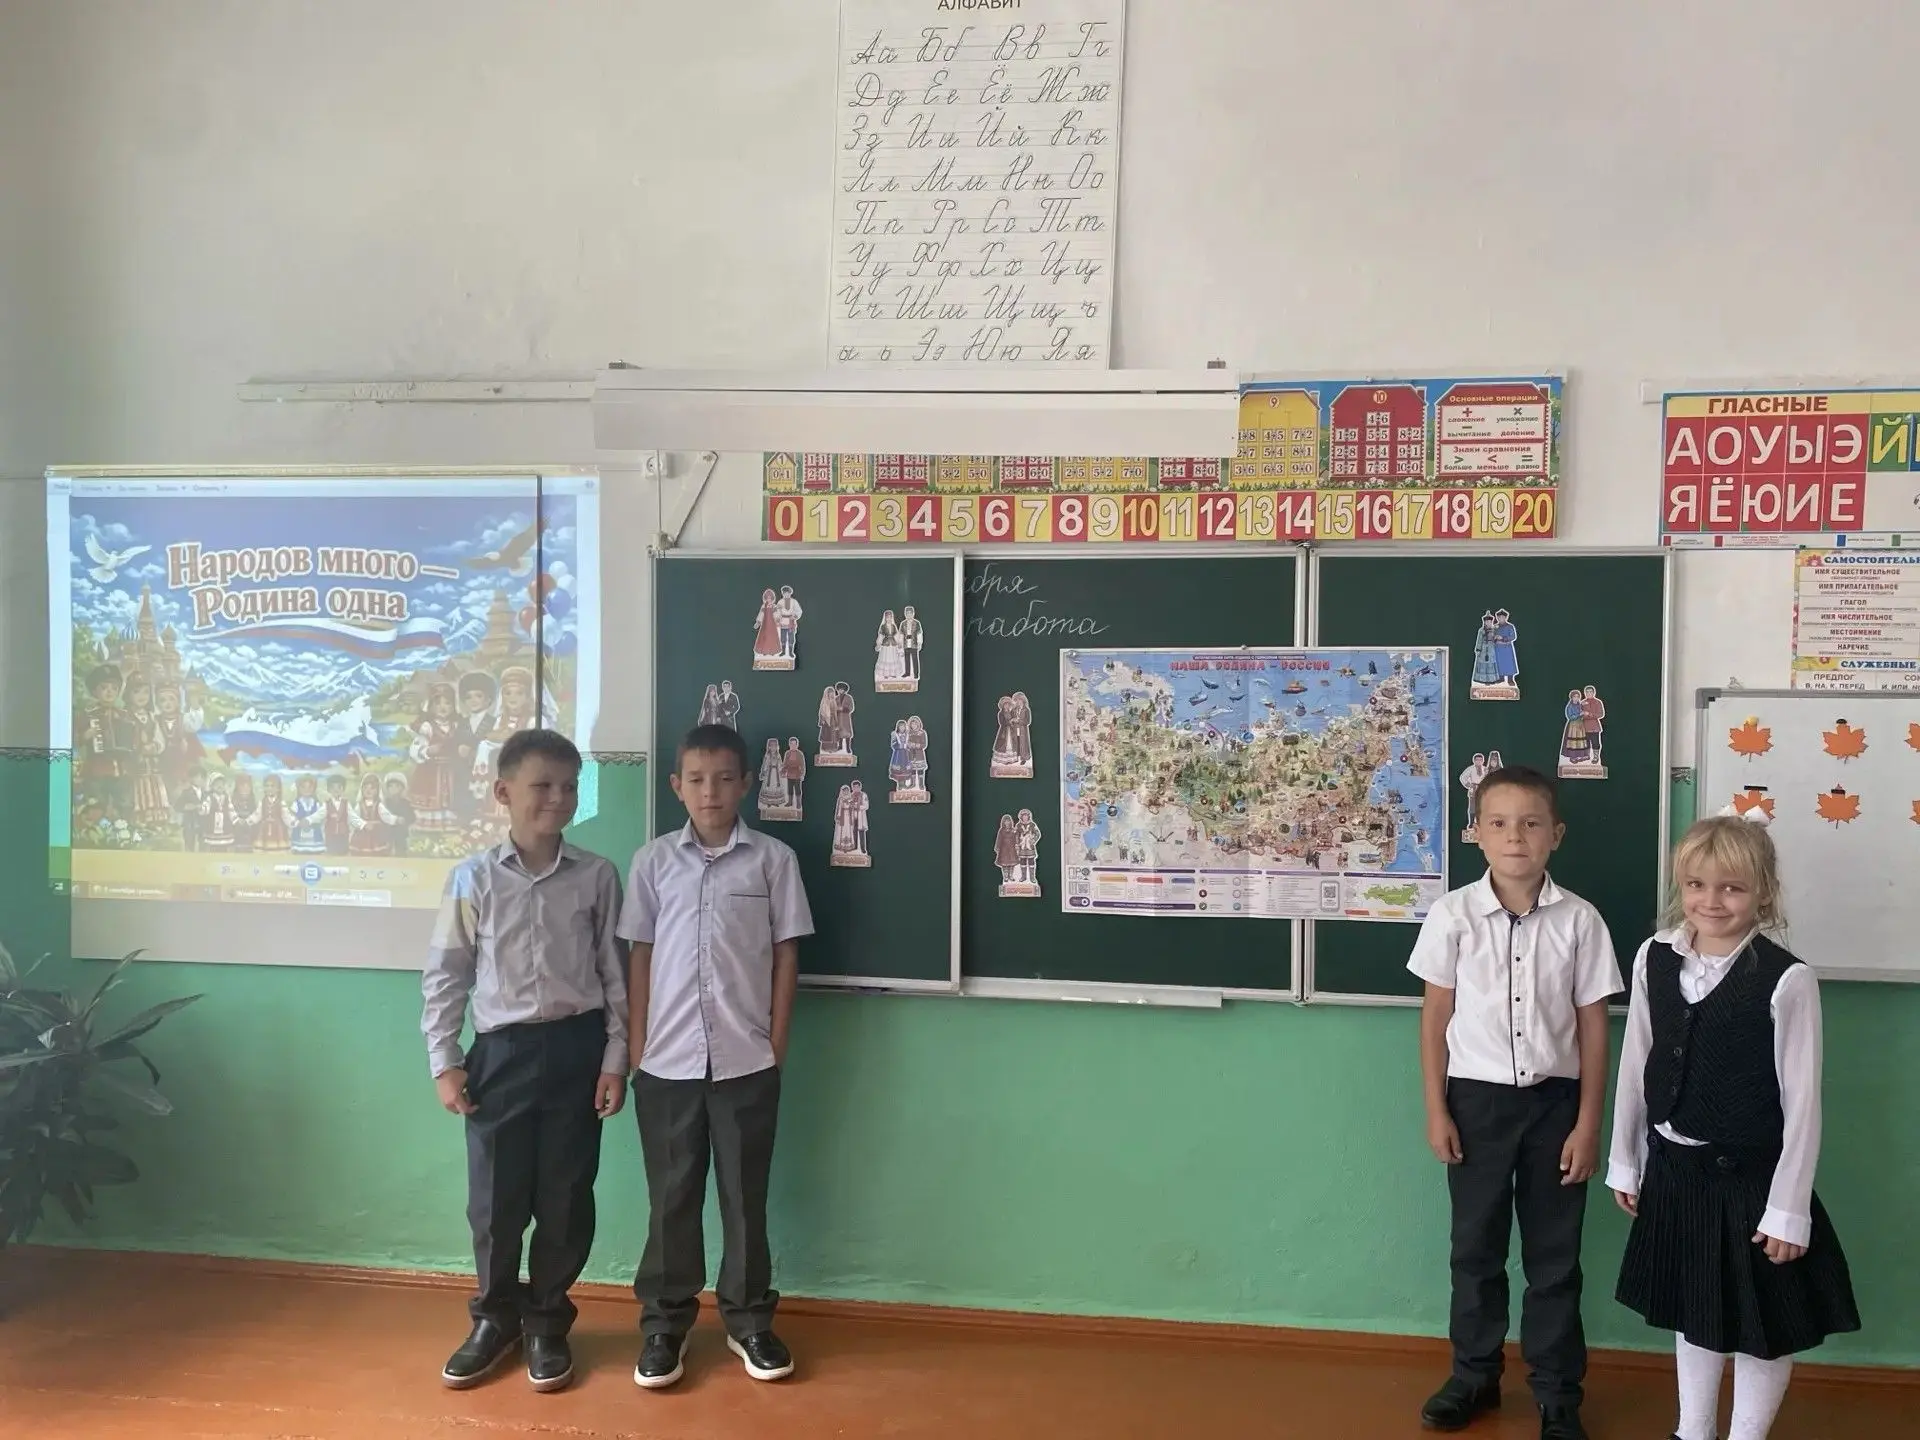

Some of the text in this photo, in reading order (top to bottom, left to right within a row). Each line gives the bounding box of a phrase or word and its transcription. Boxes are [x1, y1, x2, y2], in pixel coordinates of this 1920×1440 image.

[1450, 395, 1538, 403] Основные операции
[1708, 396, 1828, 414] ГЛАСНЫЕ
[774, 492, 1553, 538] 0 1 2 3 4 5 6 7 8 9 10 11 12 13 14 15 16 17 18 19 20
[167, 543, 312, 587] Народов
[319, 549, 417, 580] много
[191, 587, 408, 629] Родина одна
[1170, 660, 1209, 671] НАША
[1215, 660, 1265, 671] РОДИНА
[1280, 660, 1331, 671] РОССИЯ
[1841, 661, 1916, 669] СЛУЖЕБНЫЕ
